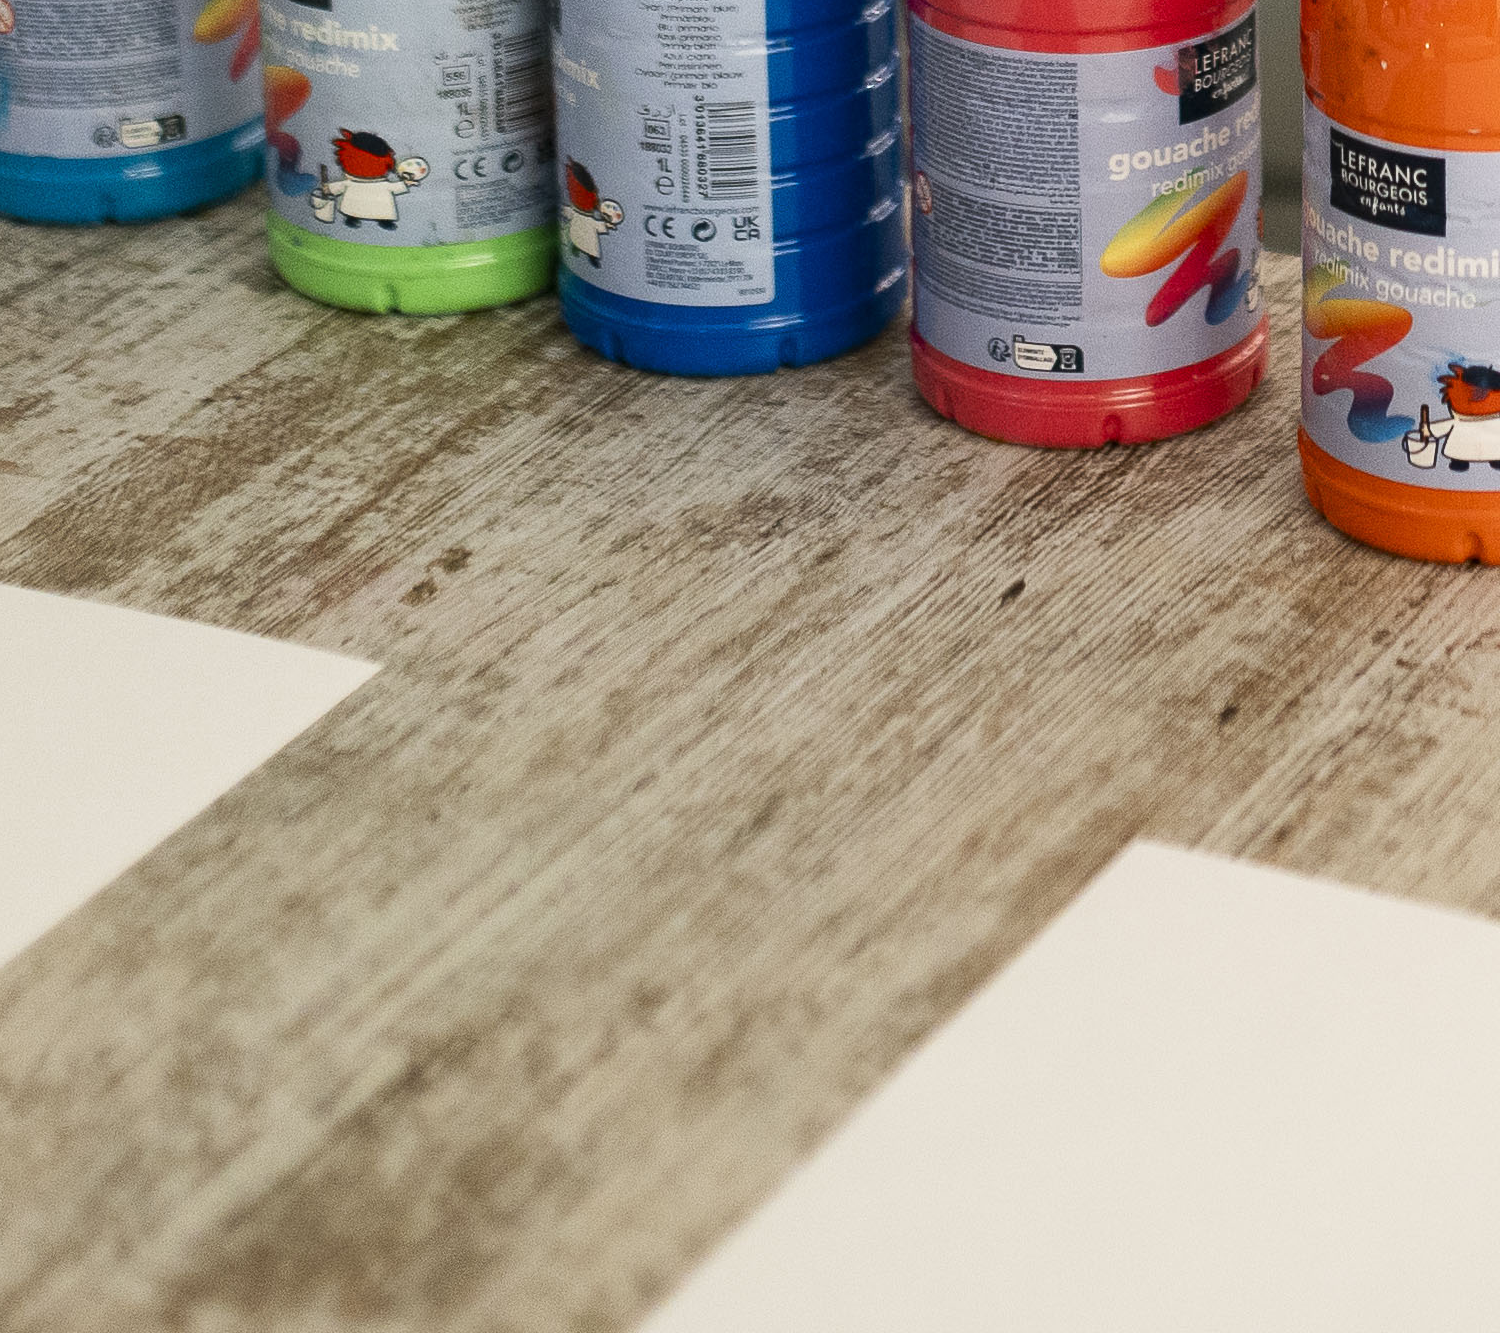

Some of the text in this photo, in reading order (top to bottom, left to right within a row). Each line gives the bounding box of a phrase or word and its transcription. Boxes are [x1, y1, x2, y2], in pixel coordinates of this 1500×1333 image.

[290, 18, 399, 52] redimix
[1109, 126, 1230, 181] gouache
[1340, 144, 1429, 188] LEFRANC
[1151, 161, 1224, 197] redimix
[1340, 169, 1429, 207] BOURGEOIS
[1375, 278, 1477, 311] gouache
